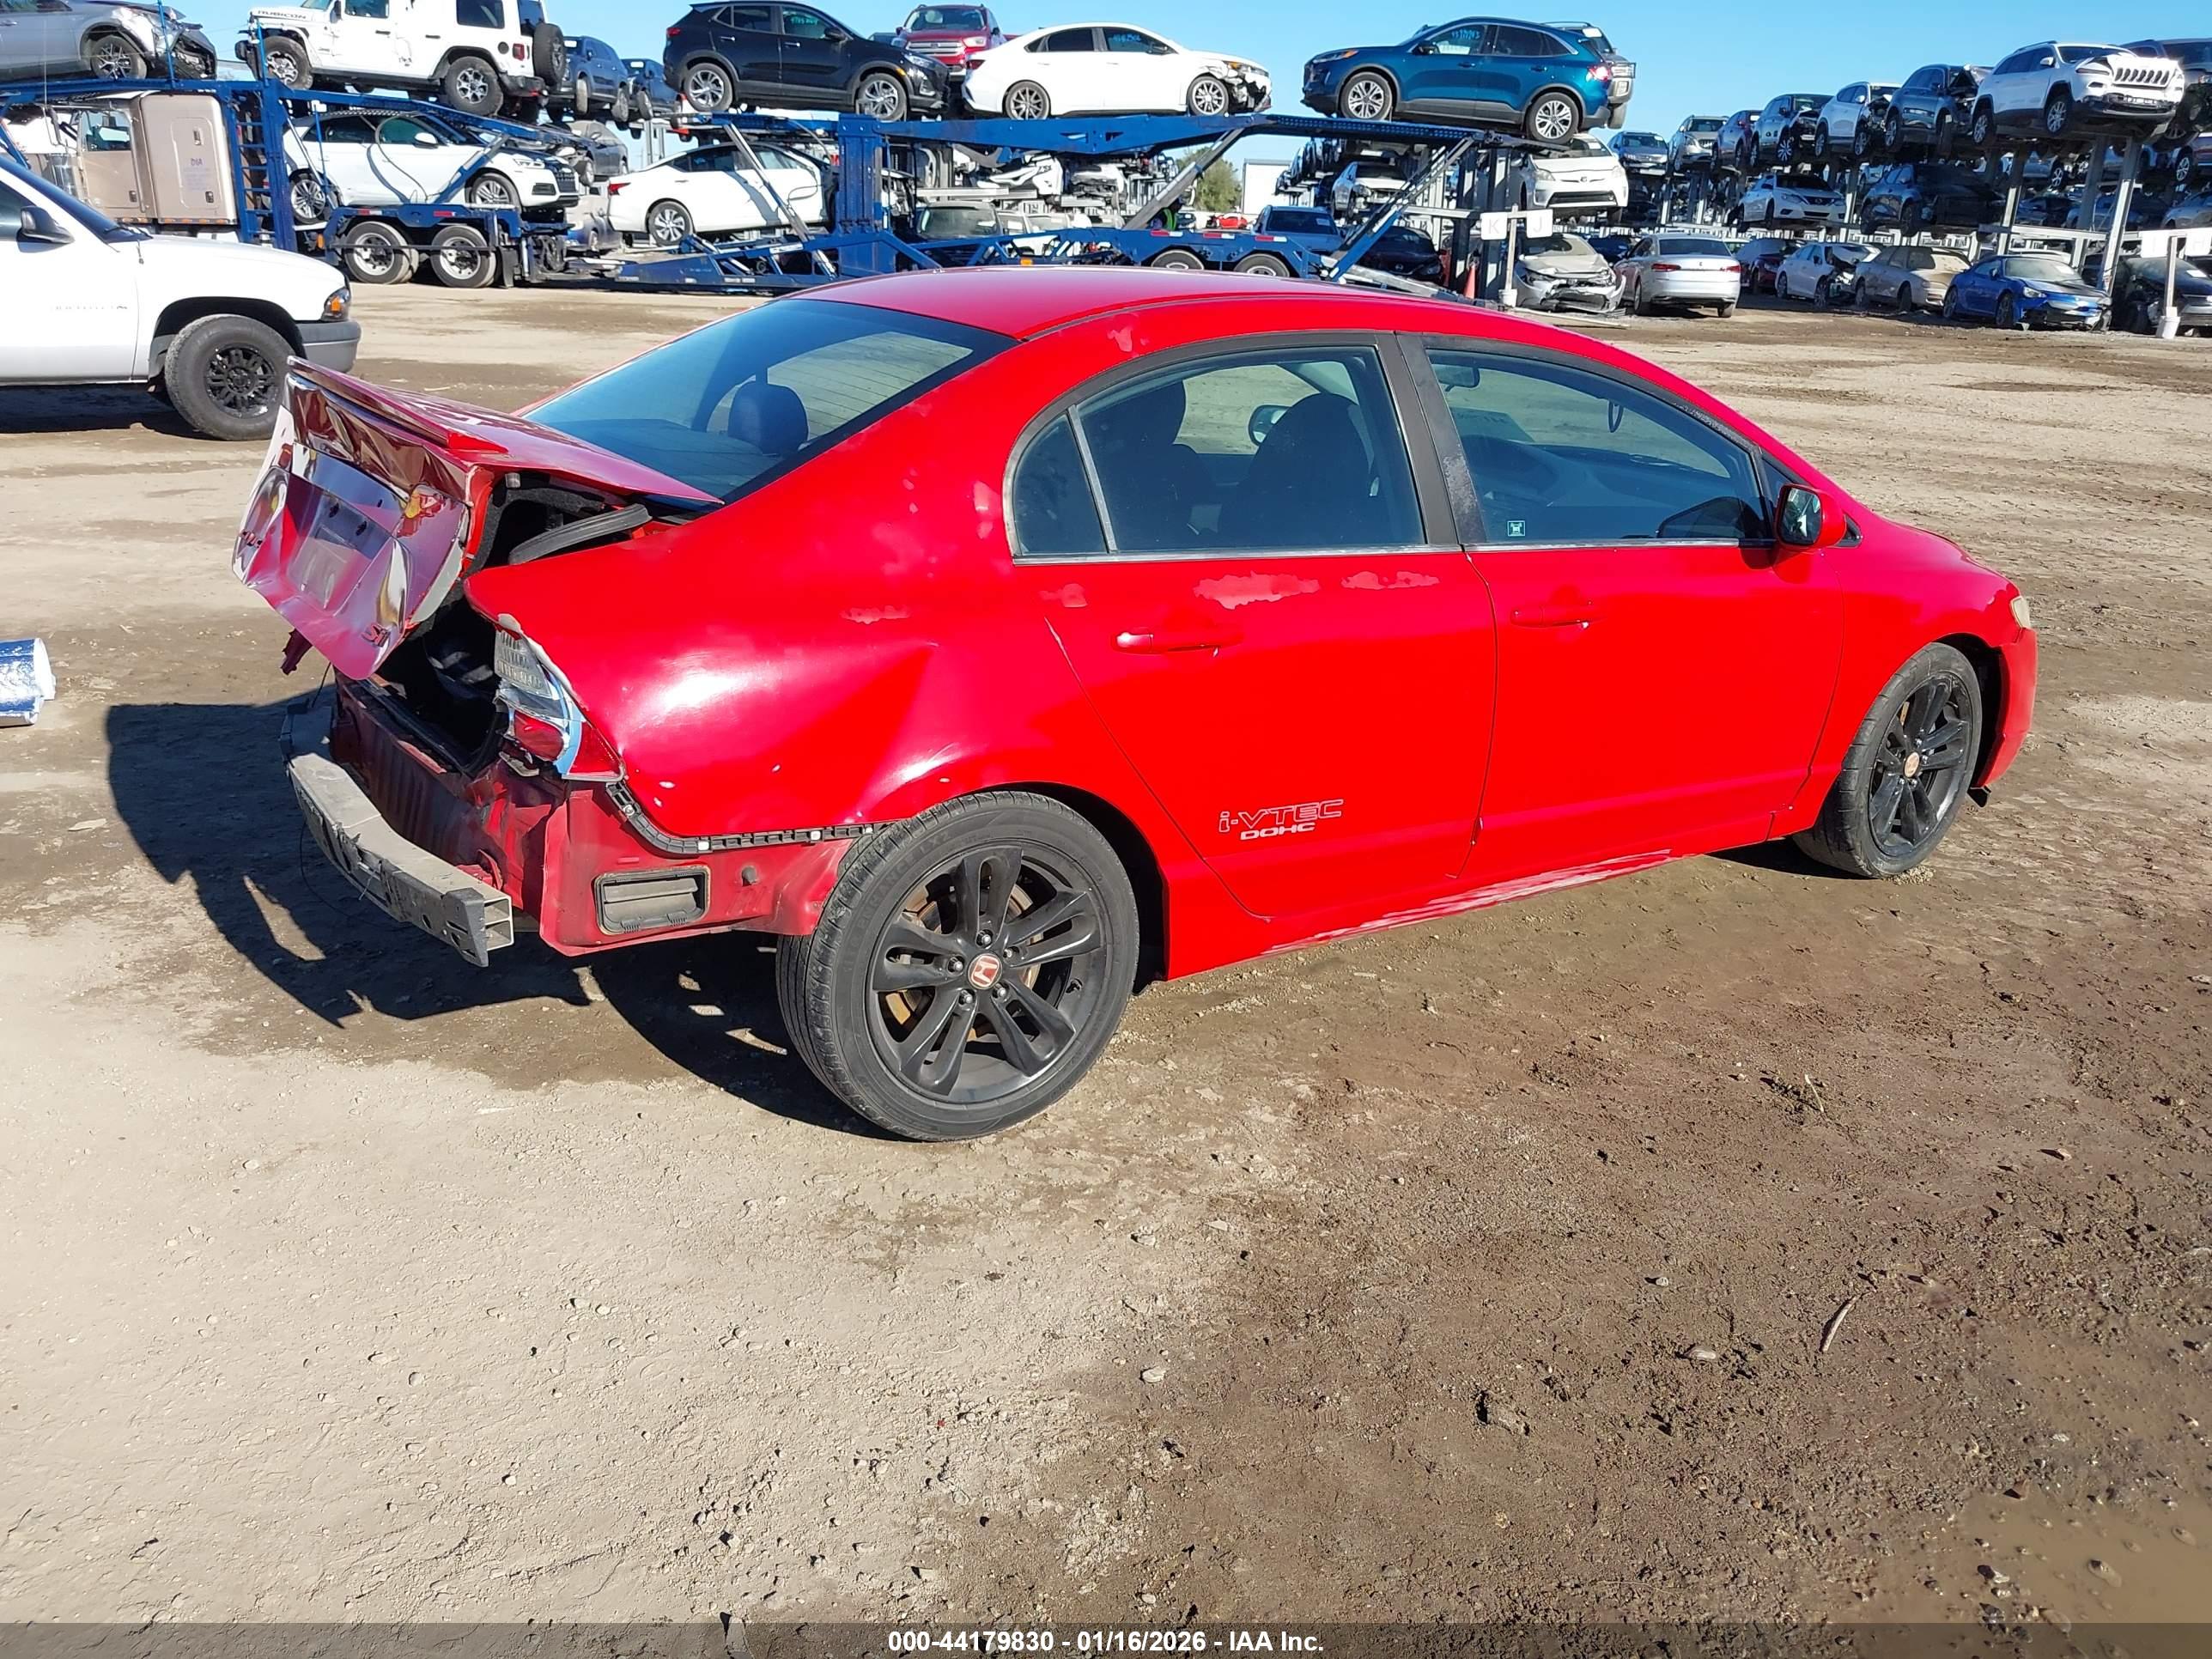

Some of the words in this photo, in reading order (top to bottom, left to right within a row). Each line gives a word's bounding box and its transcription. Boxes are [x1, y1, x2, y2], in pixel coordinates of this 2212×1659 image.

[1488, 219, 1500, 234] K
[1532, 216, 1543, 234] J
[1218, 799, 1345, 833] i-VTEC
[1240, 822, 1316, 841] DOHC
